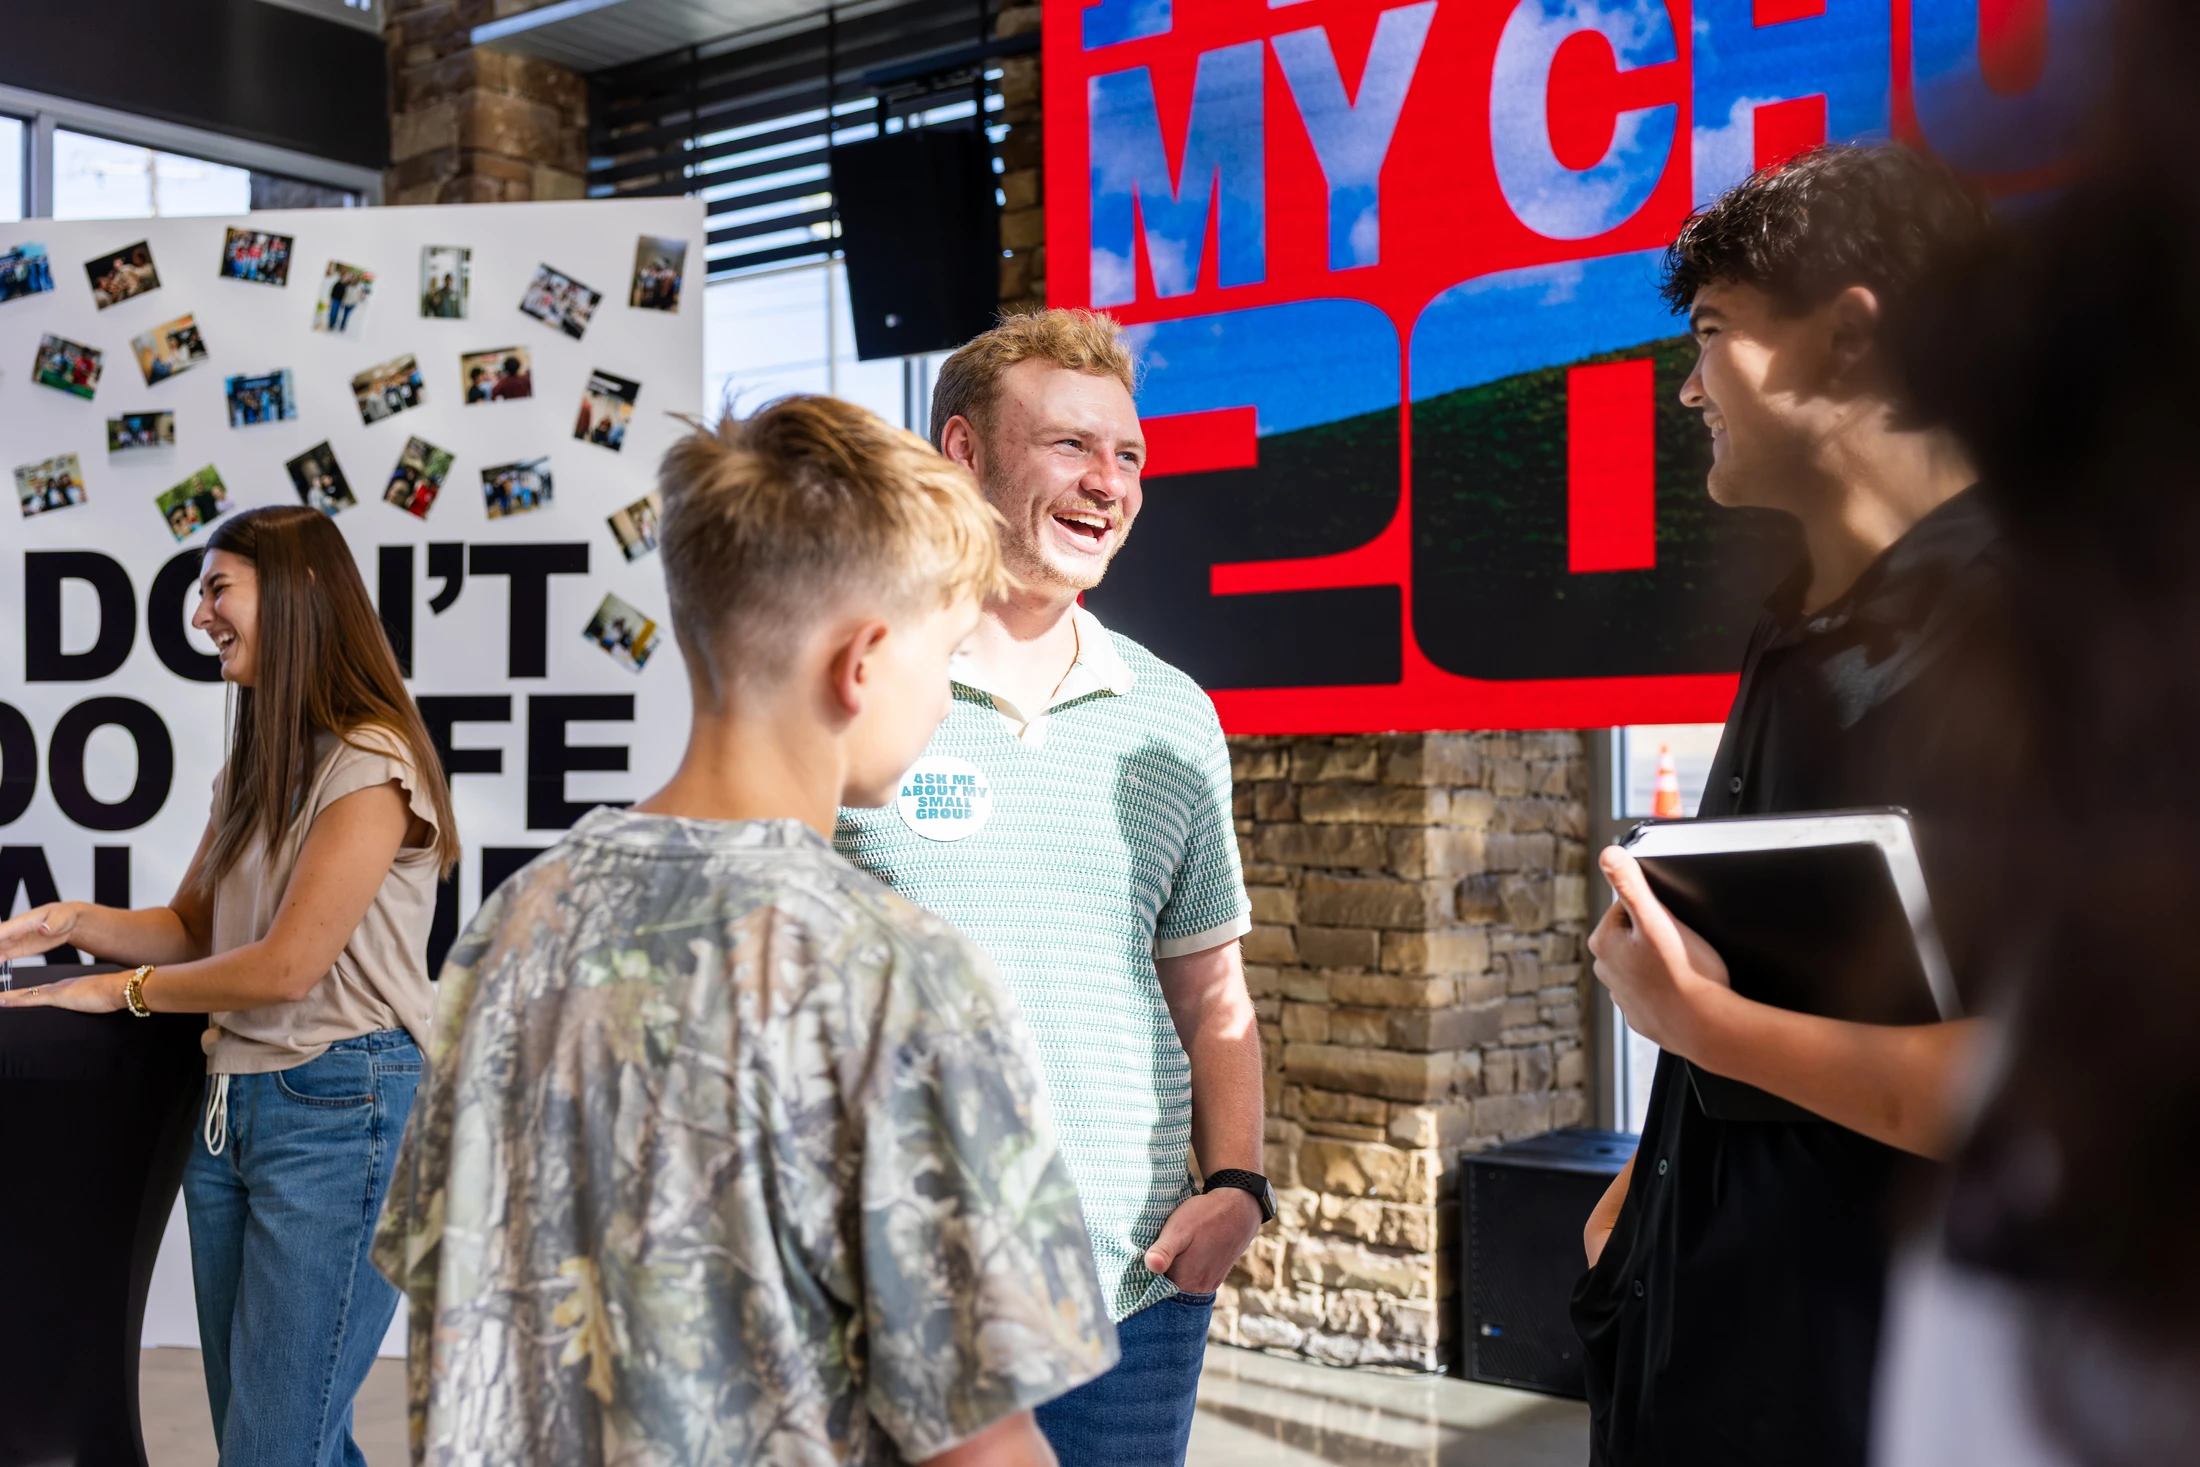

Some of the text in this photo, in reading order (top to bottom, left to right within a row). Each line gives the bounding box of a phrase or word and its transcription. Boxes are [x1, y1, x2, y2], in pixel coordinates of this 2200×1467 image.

[1088, 1, 1438, 308] MY
[414, 694, 637, 830] FE
[914, 773, 975, 785] ASK ME
[902, 785, 987, 798] ABOUT MY
[918, 797, 971, 808] SMALL
[916, 808, 974, 820] GROUP
